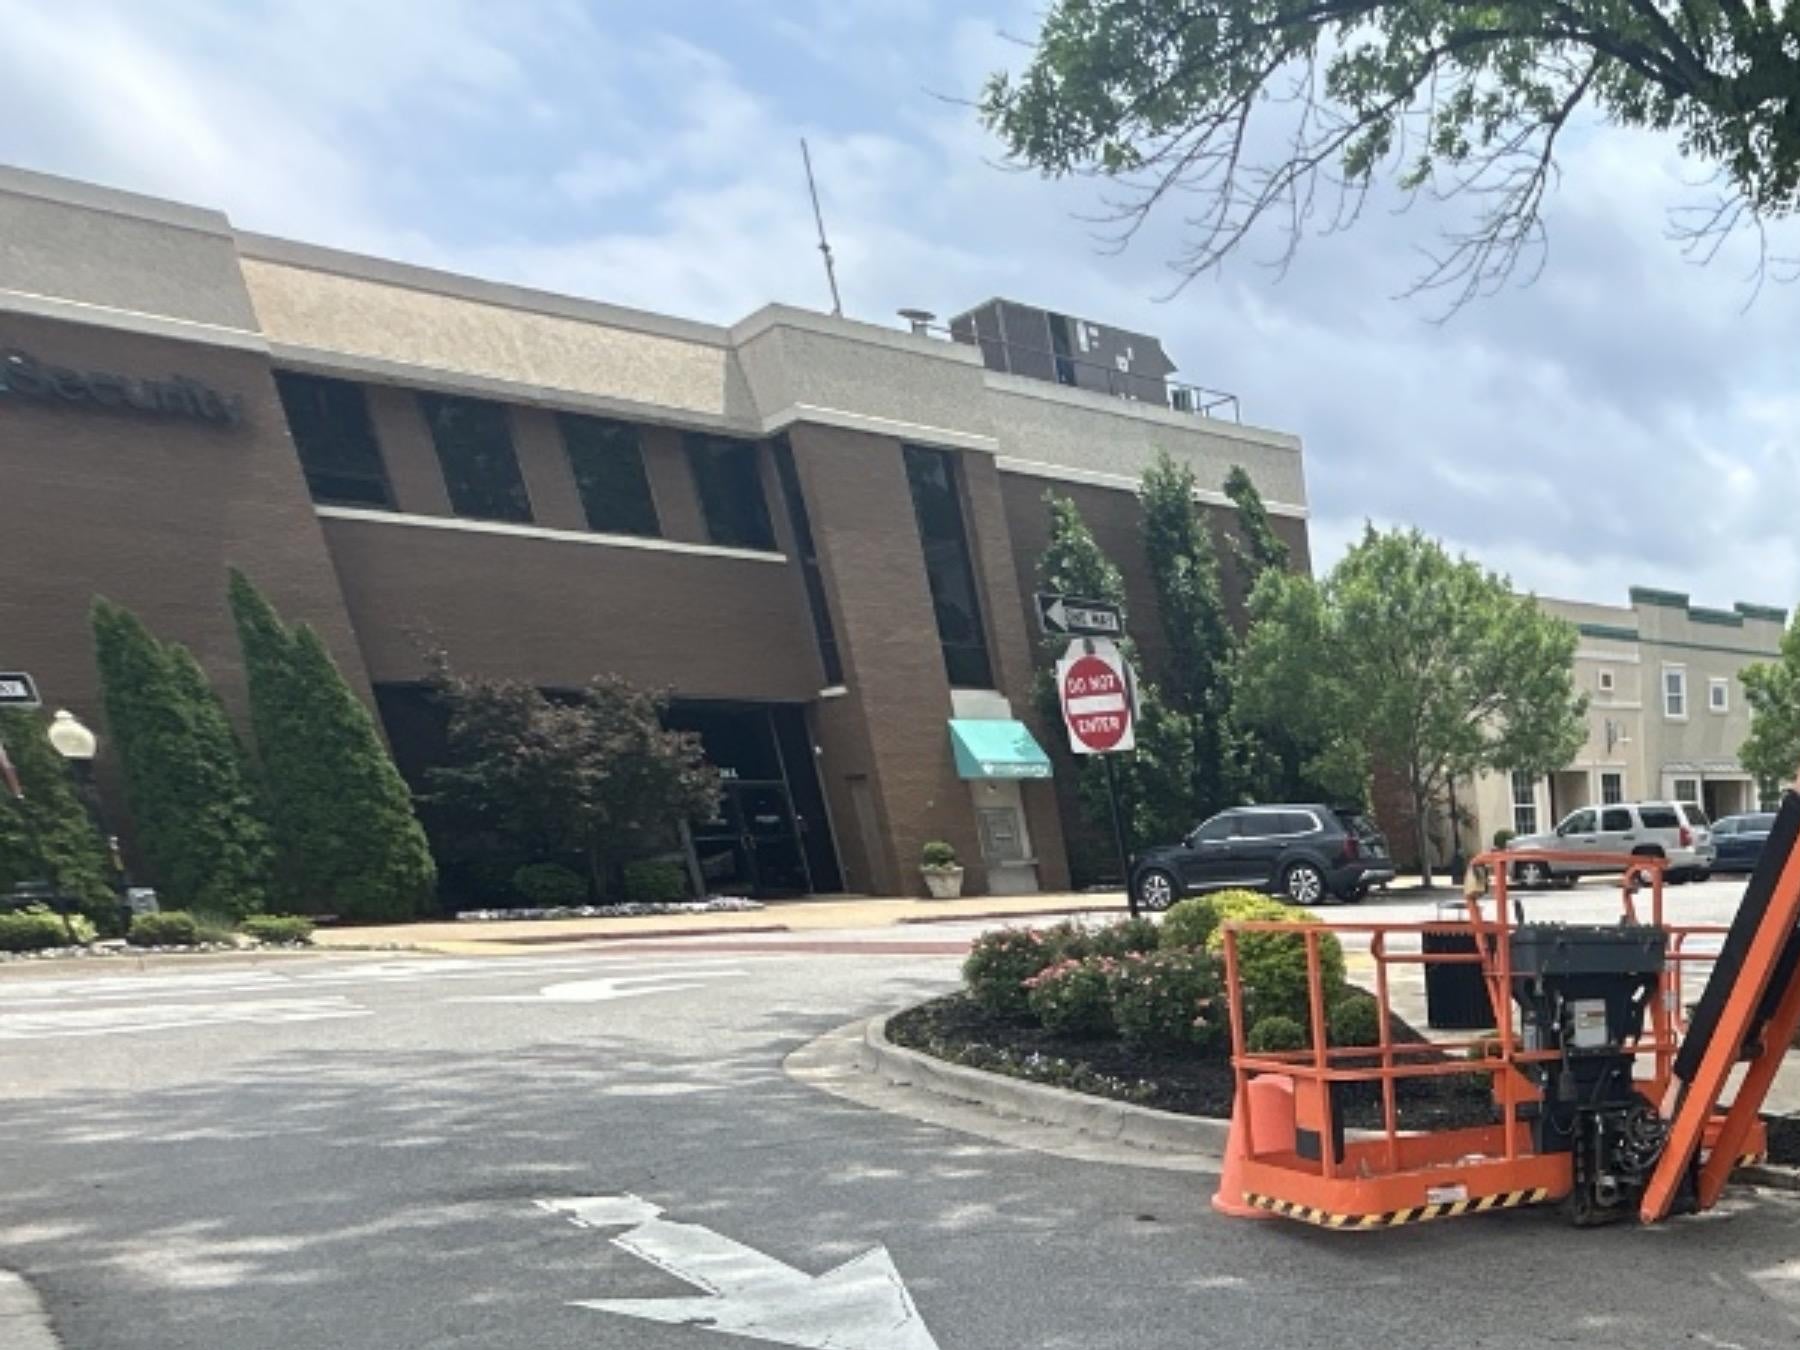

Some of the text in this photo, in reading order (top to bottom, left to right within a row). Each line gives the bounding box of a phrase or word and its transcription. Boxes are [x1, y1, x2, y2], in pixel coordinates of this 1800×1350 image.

[1067, 674, 1114, 694] DO NOT
[1077, 716, 1120, 733] ENTER
